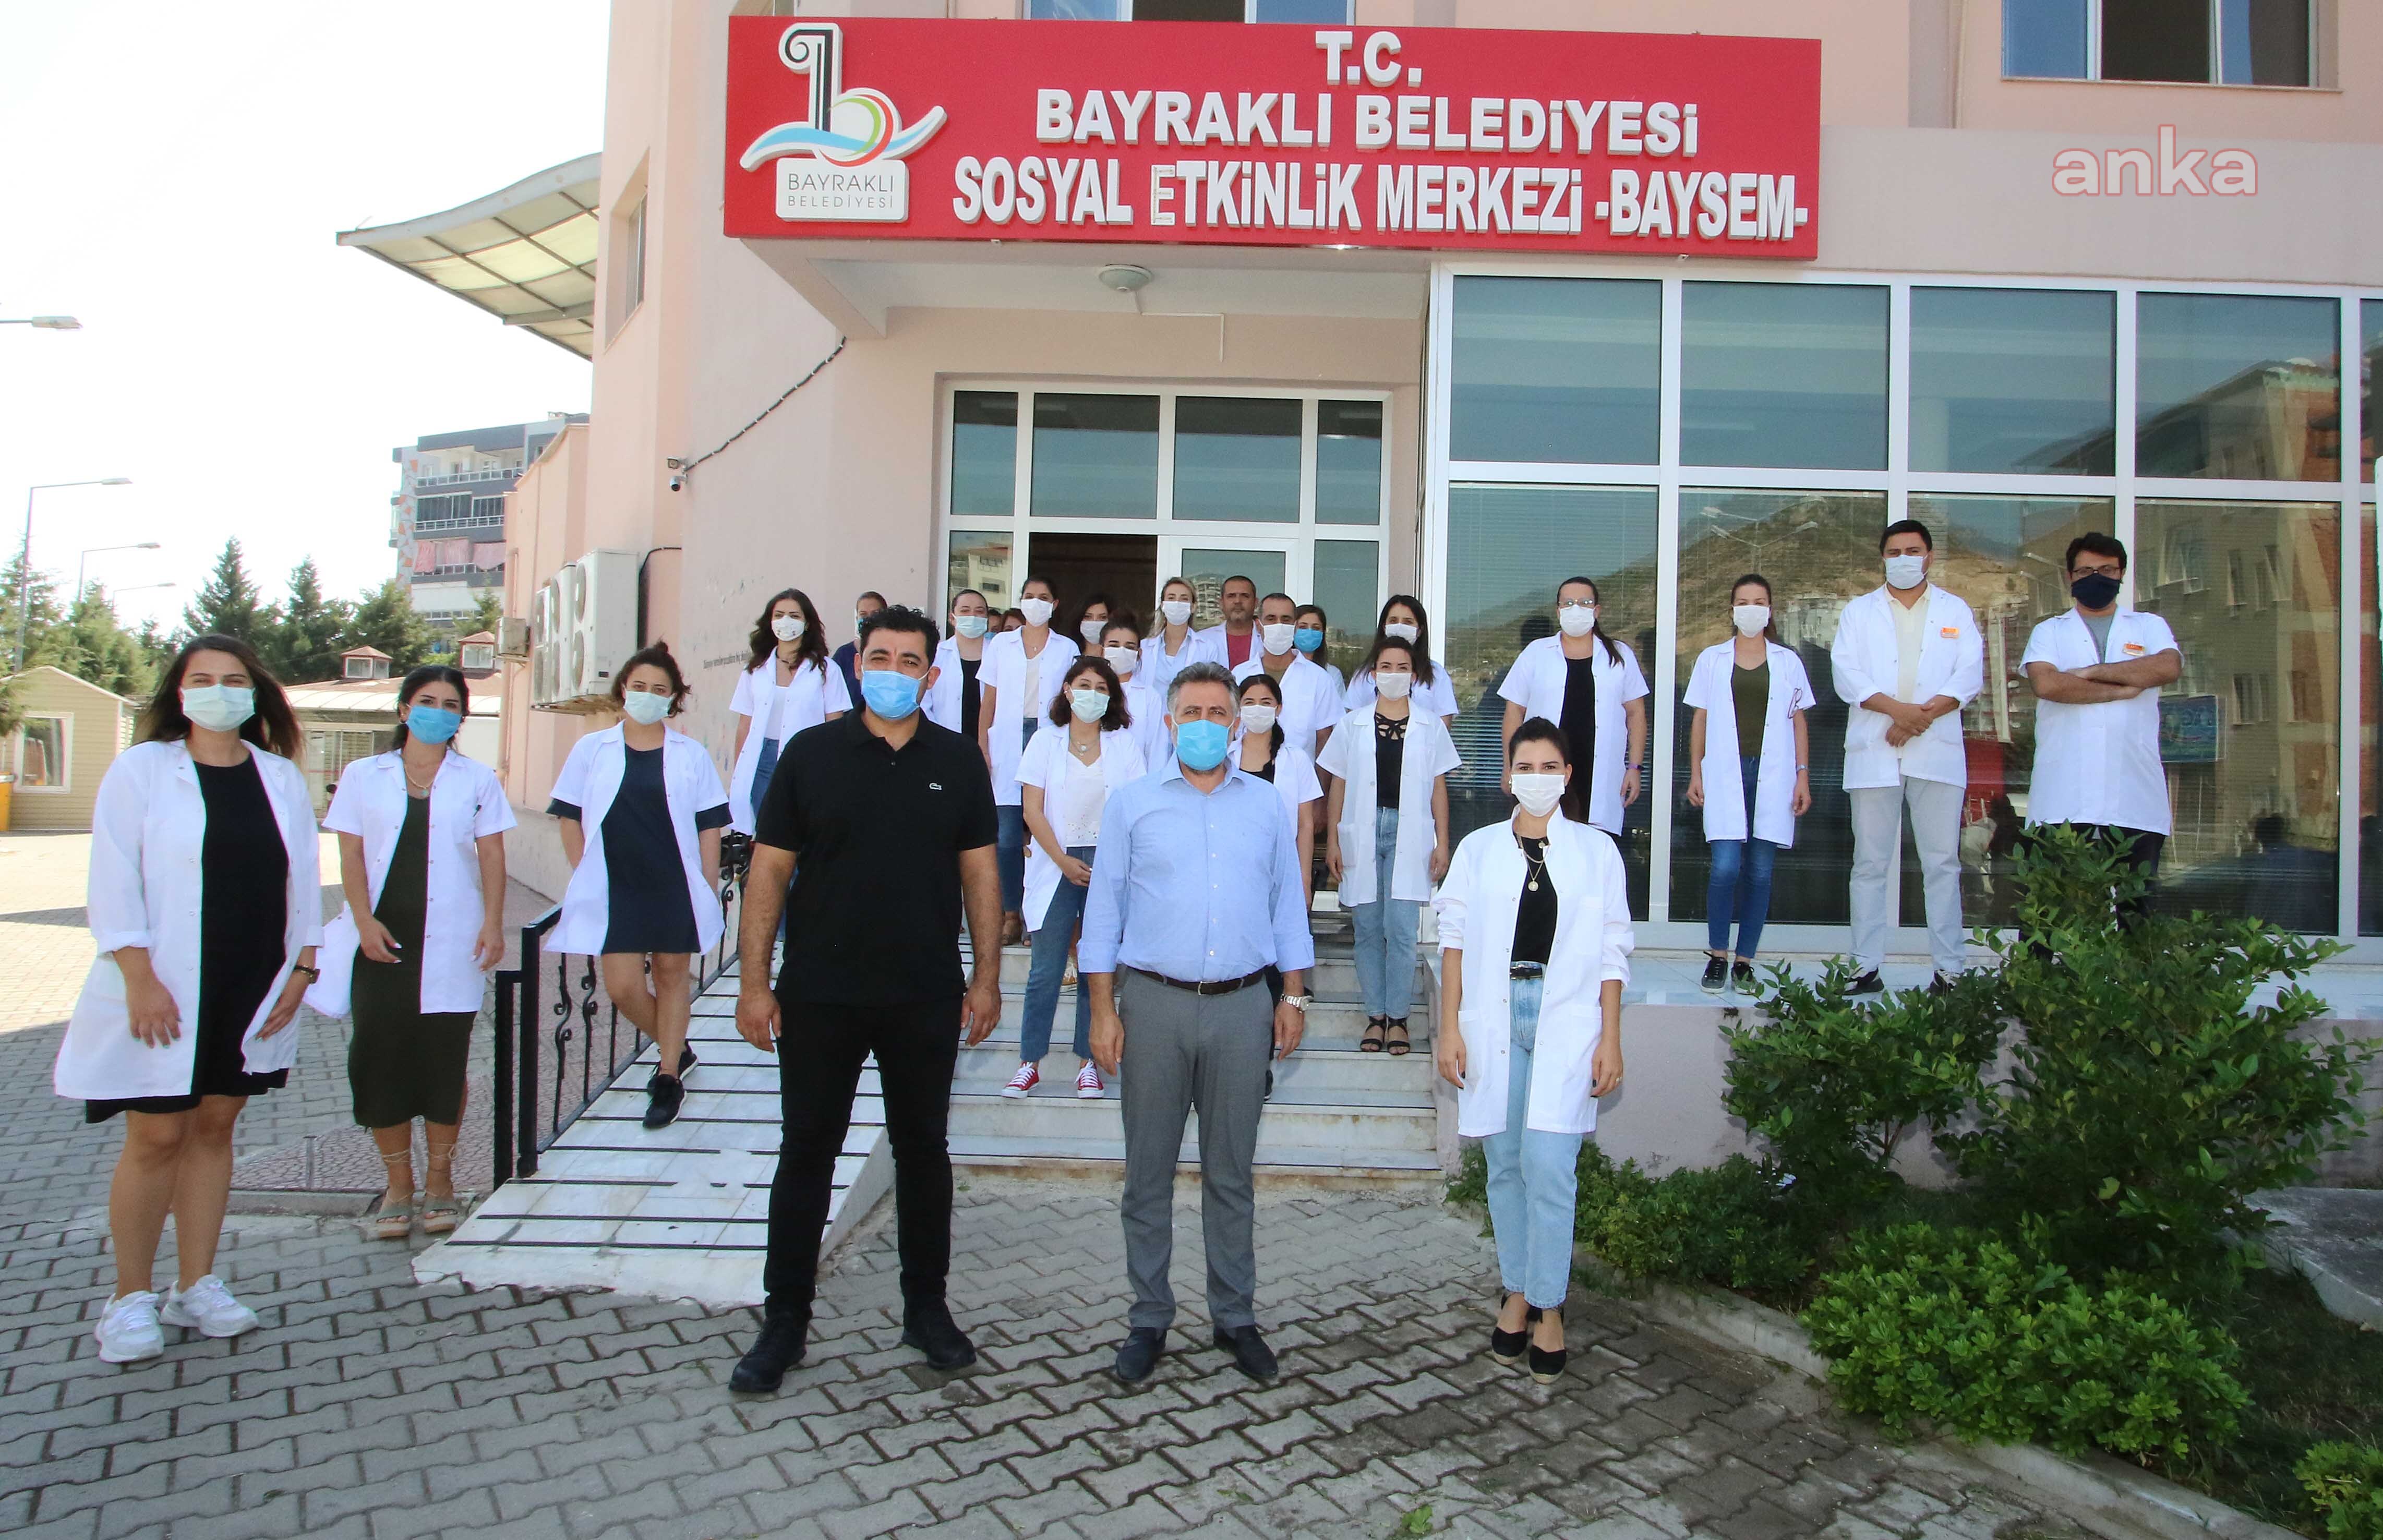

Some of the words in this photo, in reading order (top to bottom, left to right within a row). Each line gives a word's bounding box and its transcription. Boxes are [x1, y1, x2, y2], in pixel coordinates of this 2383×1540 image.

[1315, 31, 1422, 88] T.C.
[1036, 88, 1331, 148] BAYRAKLI
[788, 173, 893, 192] BAYRAKLI
[953, 156, 1134, 225] SOSYAL
